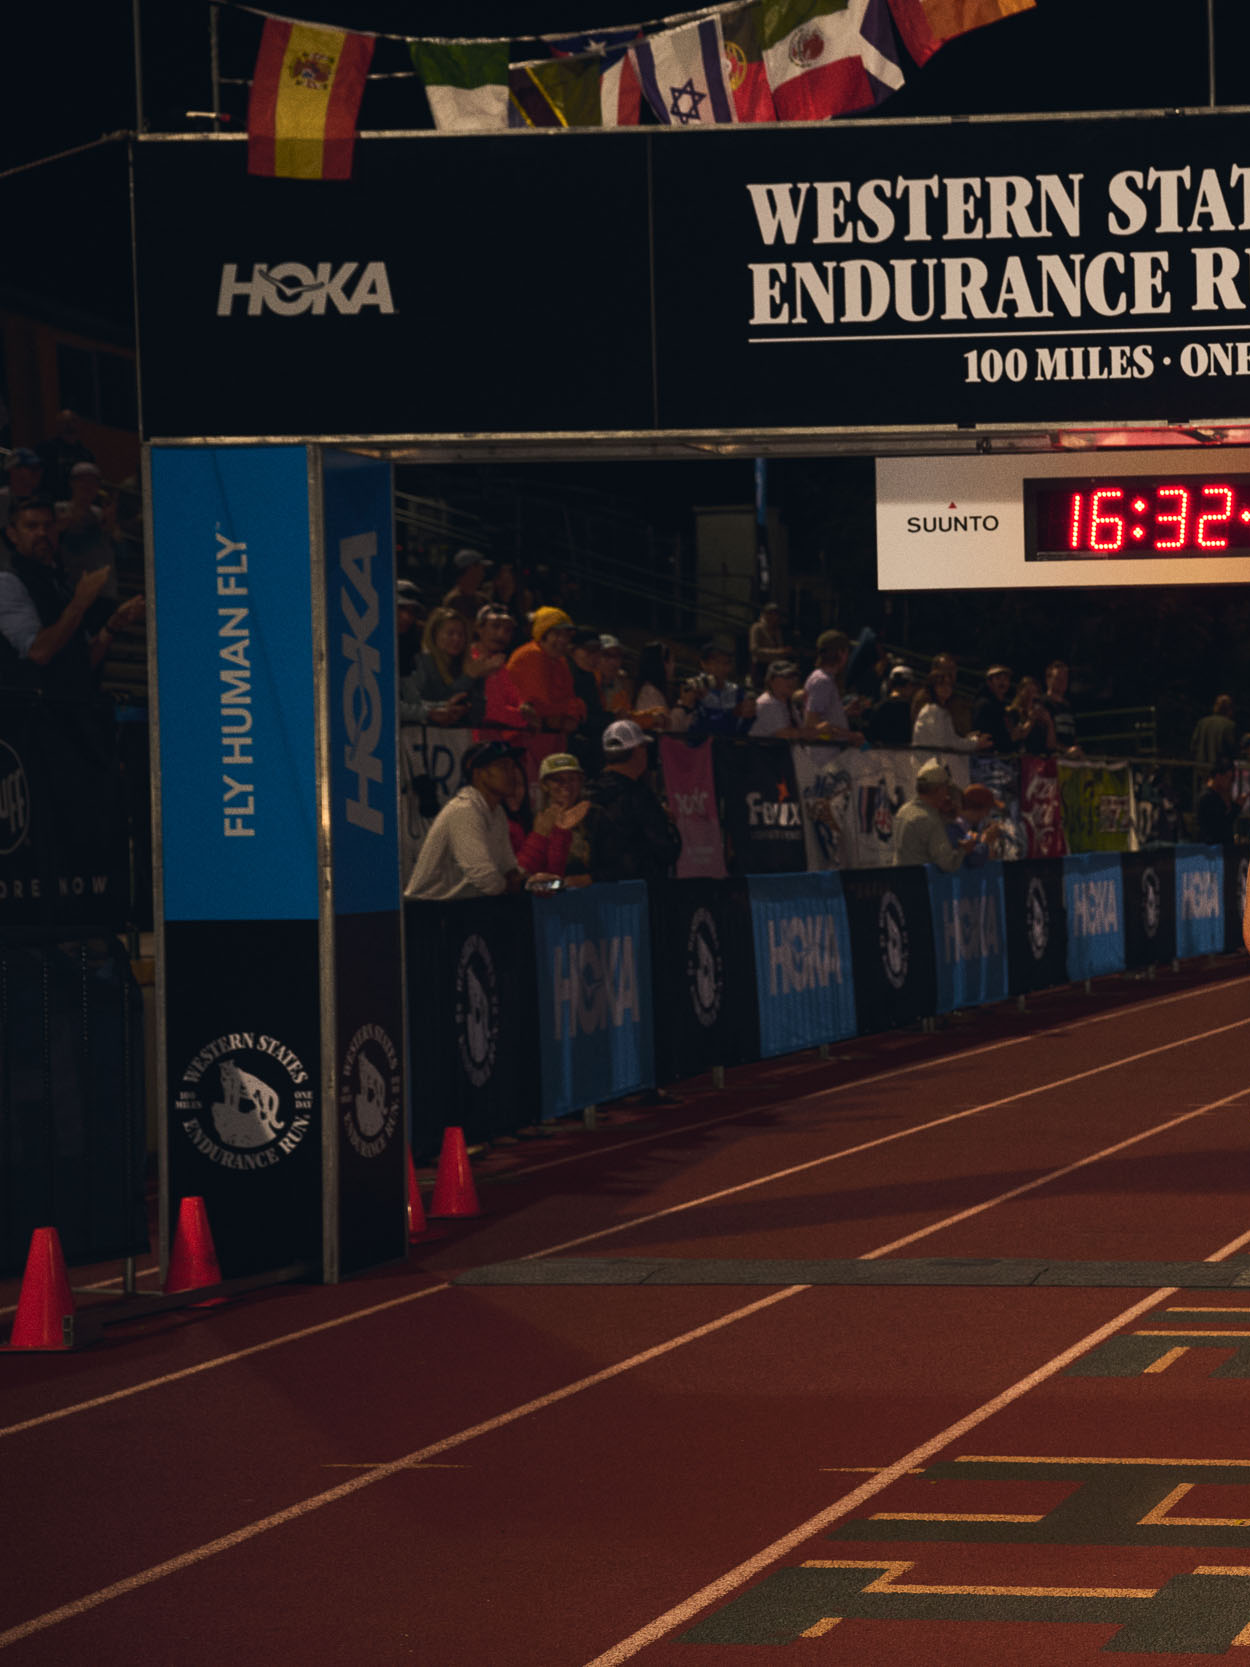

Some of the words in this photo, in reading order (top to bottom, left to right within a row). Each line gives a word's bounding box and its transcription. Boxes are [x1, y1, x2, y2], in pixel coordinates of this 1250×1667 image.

[747, 173, 1084, 245] WESTERN
[217, 261, 395, 317] HOKA
[748, 249, 1173, 326] ENDURANCE
[963, 348, 1028, 383] 100
[1034, 344, 1155, 381] MILES
[907, 514, 1000, 535] SUUNTO
[215, 533, 248, 597] FLY
[218, 607, 253, 765] HUMAN
[339, 530, 385, 836] HOKA
[223, 775, 255, 838] FLY
[1073, 879, 1118, 938] HOKA
[1181, 870, 1220, 921] HOKA
[767, 914, 844, 997] HOKA
[942, 895, 1000, 964] HOKA
[553, 935, 641, 1041] HOKA
[182, 1031, 256, 1083] WESTERN
[256, 1033, 309, 1085] STATES
[293, 1090, 314, 1099] ONE
[295, 1100, 314, 1110] DAY
[182, 1117, 280, 1171] ENDURANCE
[278, 1116, 312, 1155] RUN
